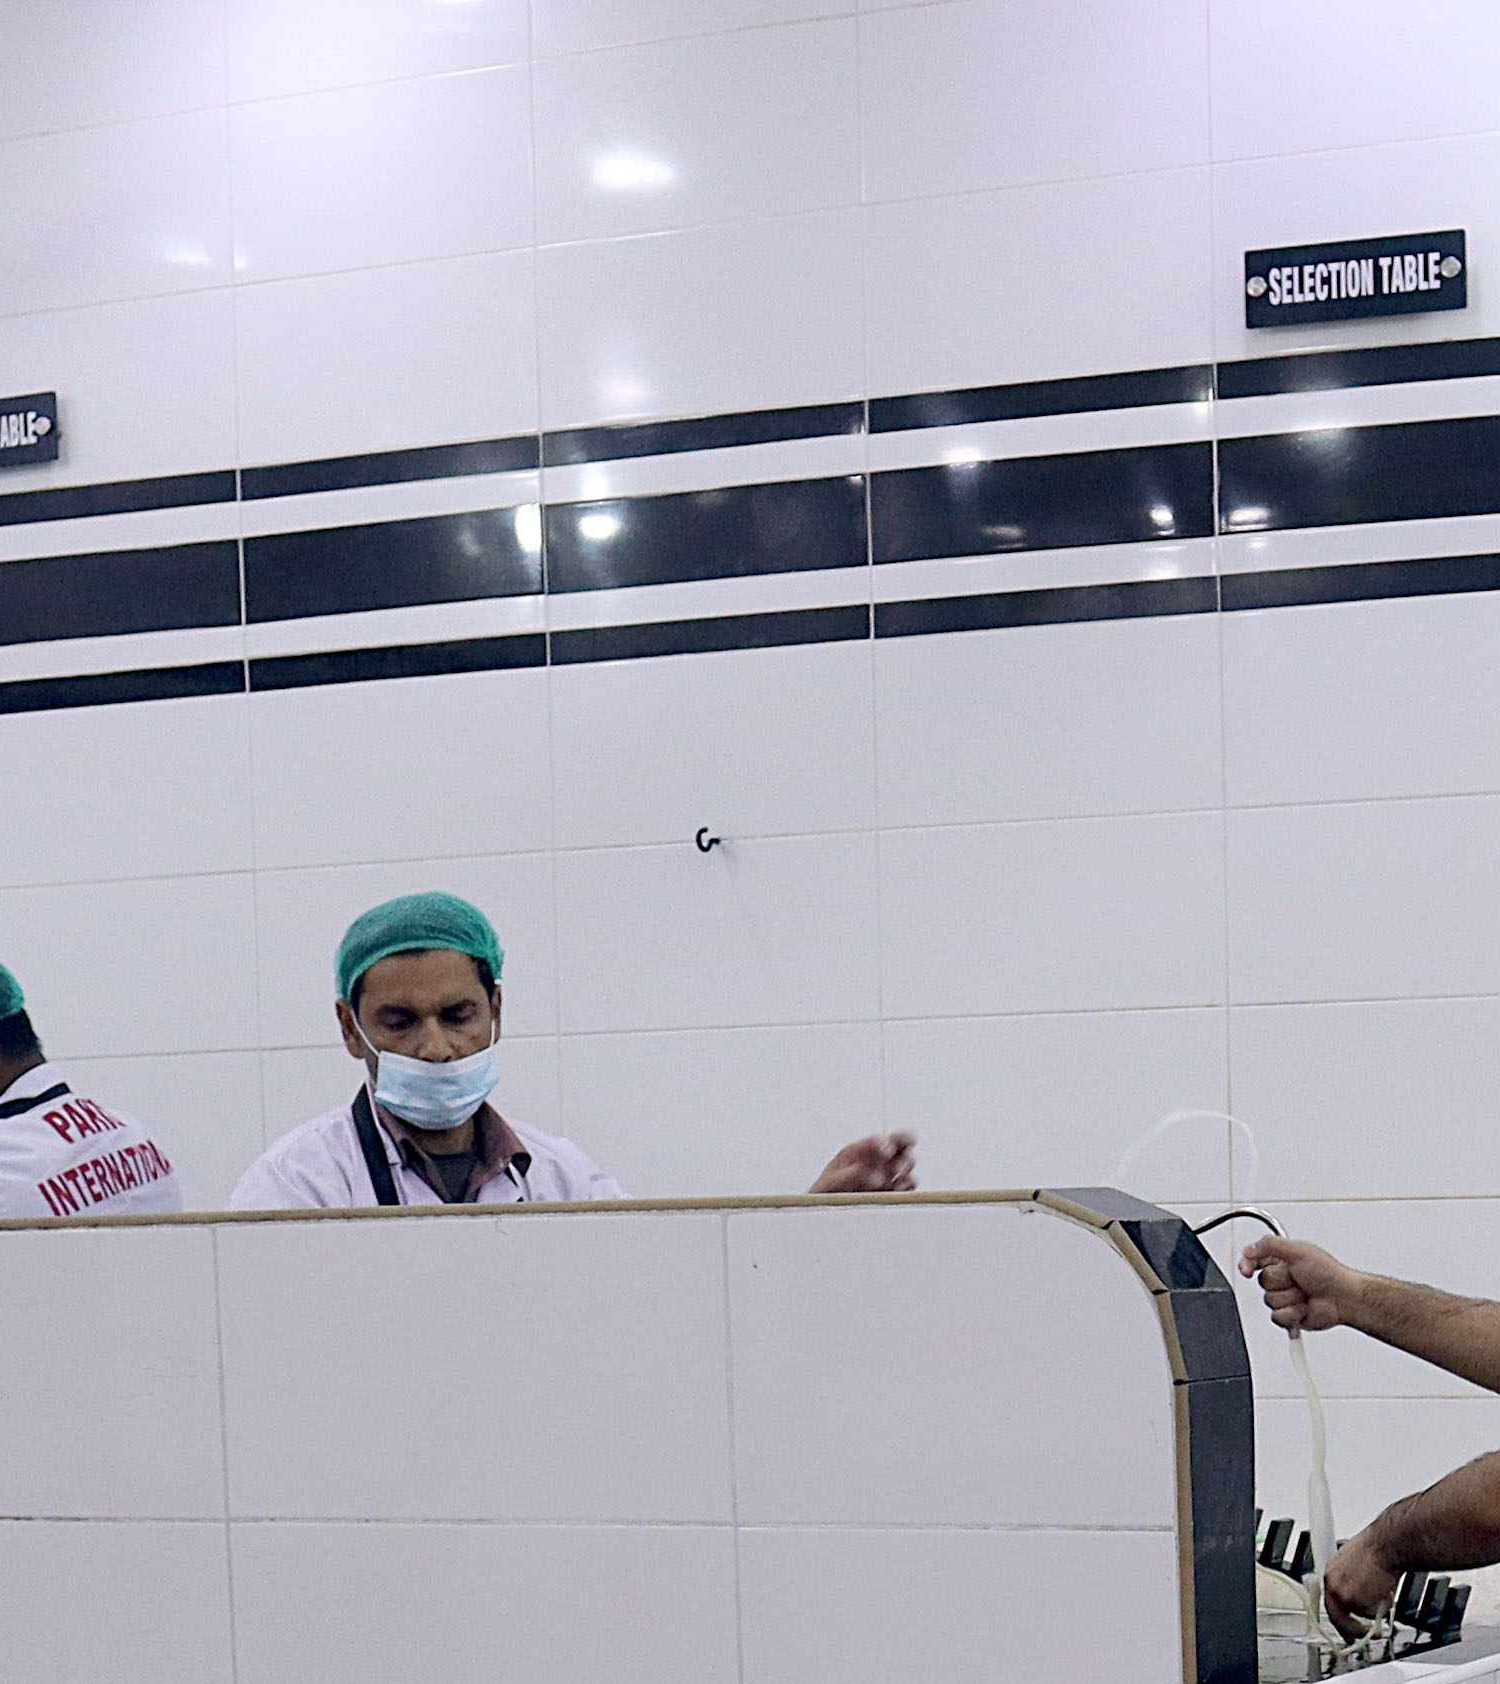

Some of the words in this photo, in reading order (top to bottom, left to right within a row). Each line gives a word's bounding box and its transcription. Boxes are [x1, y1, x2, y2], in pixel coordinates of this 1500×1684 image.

[1267, 257, 1375, 307] SELECTION
[1378, 251, 1442, 295] TABLE
[42, 1098, 126, 1143] PAK
